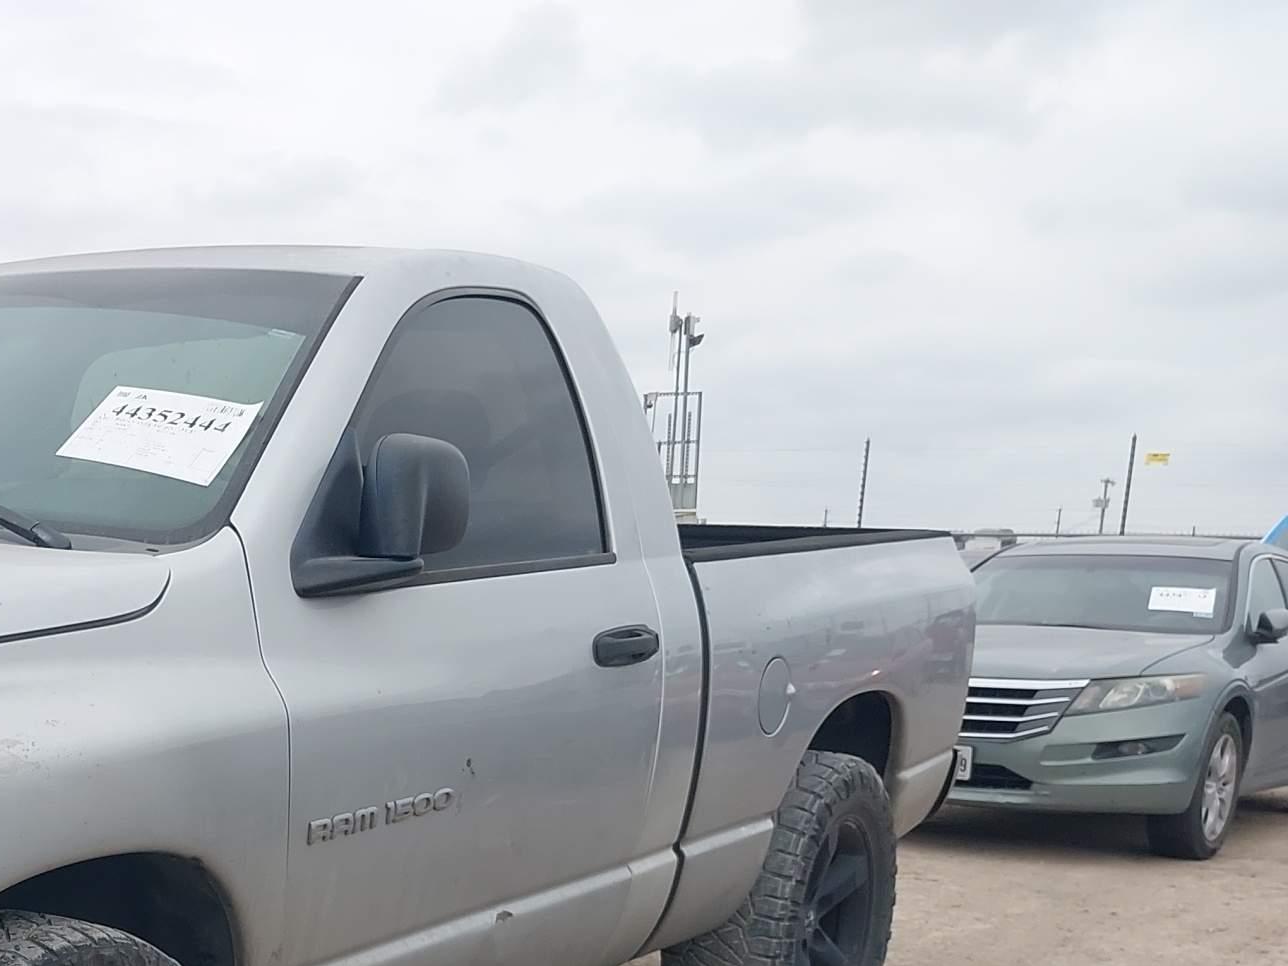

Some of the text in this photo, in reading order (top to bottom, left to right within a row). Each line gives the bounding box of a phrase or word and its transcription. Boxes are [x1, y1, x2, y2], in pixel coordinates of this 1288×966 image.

[111, 403, 232, 432] 44352444
[307, 787, 456, 846] RAM 1500
